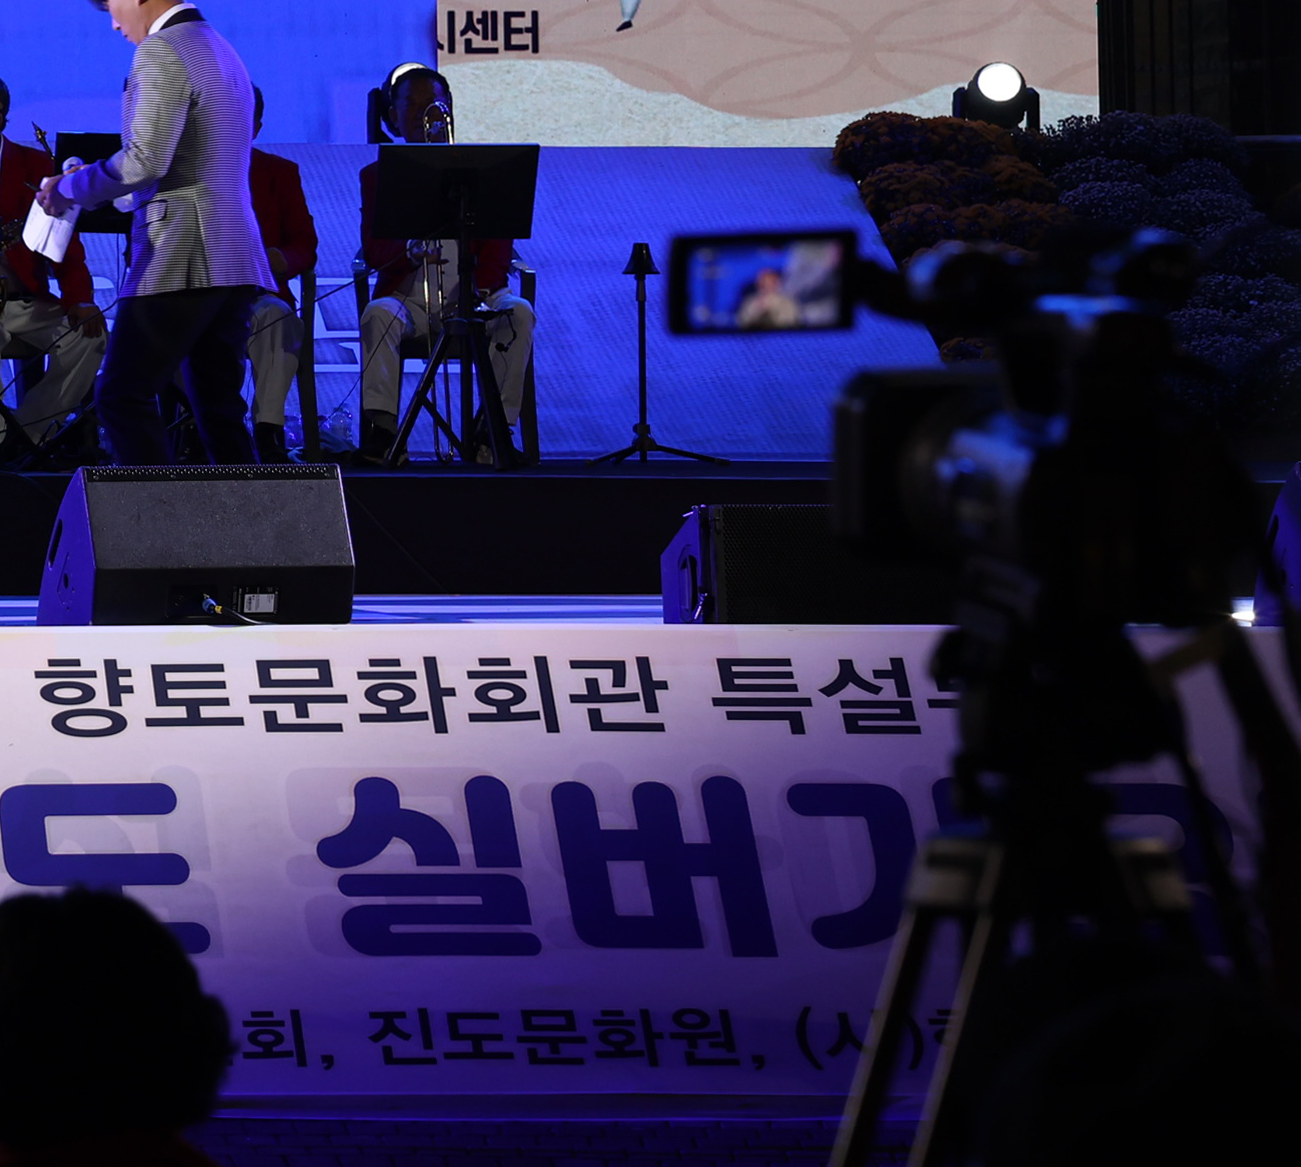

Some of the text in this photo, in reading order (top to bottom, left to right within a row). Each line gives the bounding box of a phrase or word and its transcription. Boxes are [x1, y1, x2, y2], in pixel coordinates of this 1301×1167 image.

[33, 655, 672, 739] 향토문화회관
[710, 656, 959, 737] 특설
[367, 1007, 766, 1070] 진도문화원,
